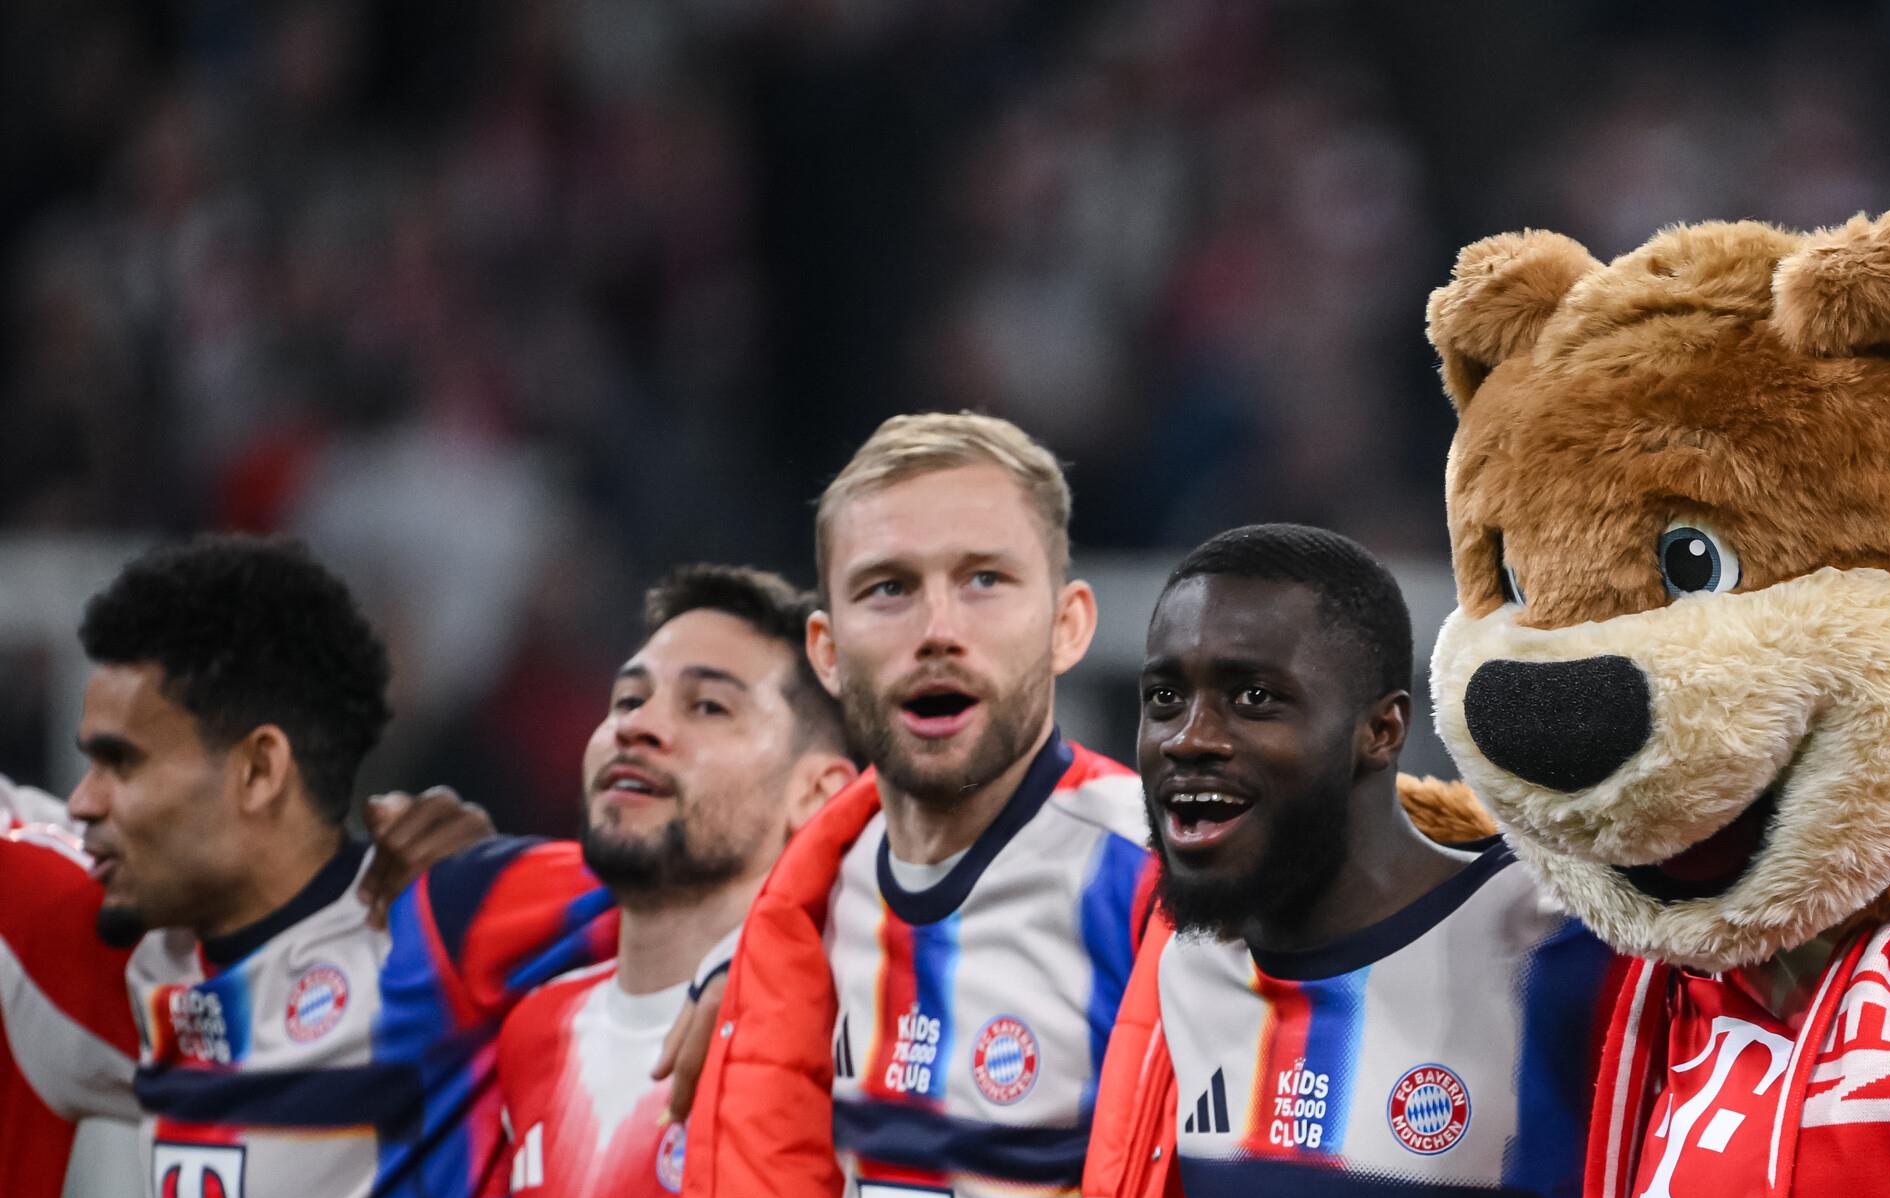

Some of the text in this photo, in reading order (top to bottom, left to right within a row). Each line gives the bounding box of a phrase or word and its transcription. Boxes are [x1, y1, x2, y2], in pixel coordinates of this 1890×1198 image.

[898, 1014, 941, 1044] KIDS
[885, 1062, 931, 1094] CLUB
[1277, 1070, 1330, 1099] KIDS
[1395, 1071, 1465, 1107] FC BAYERN
[1274, 1097, 1327, 1119] 75.000
[1269, 1119, 1323, 1149] CLUB
